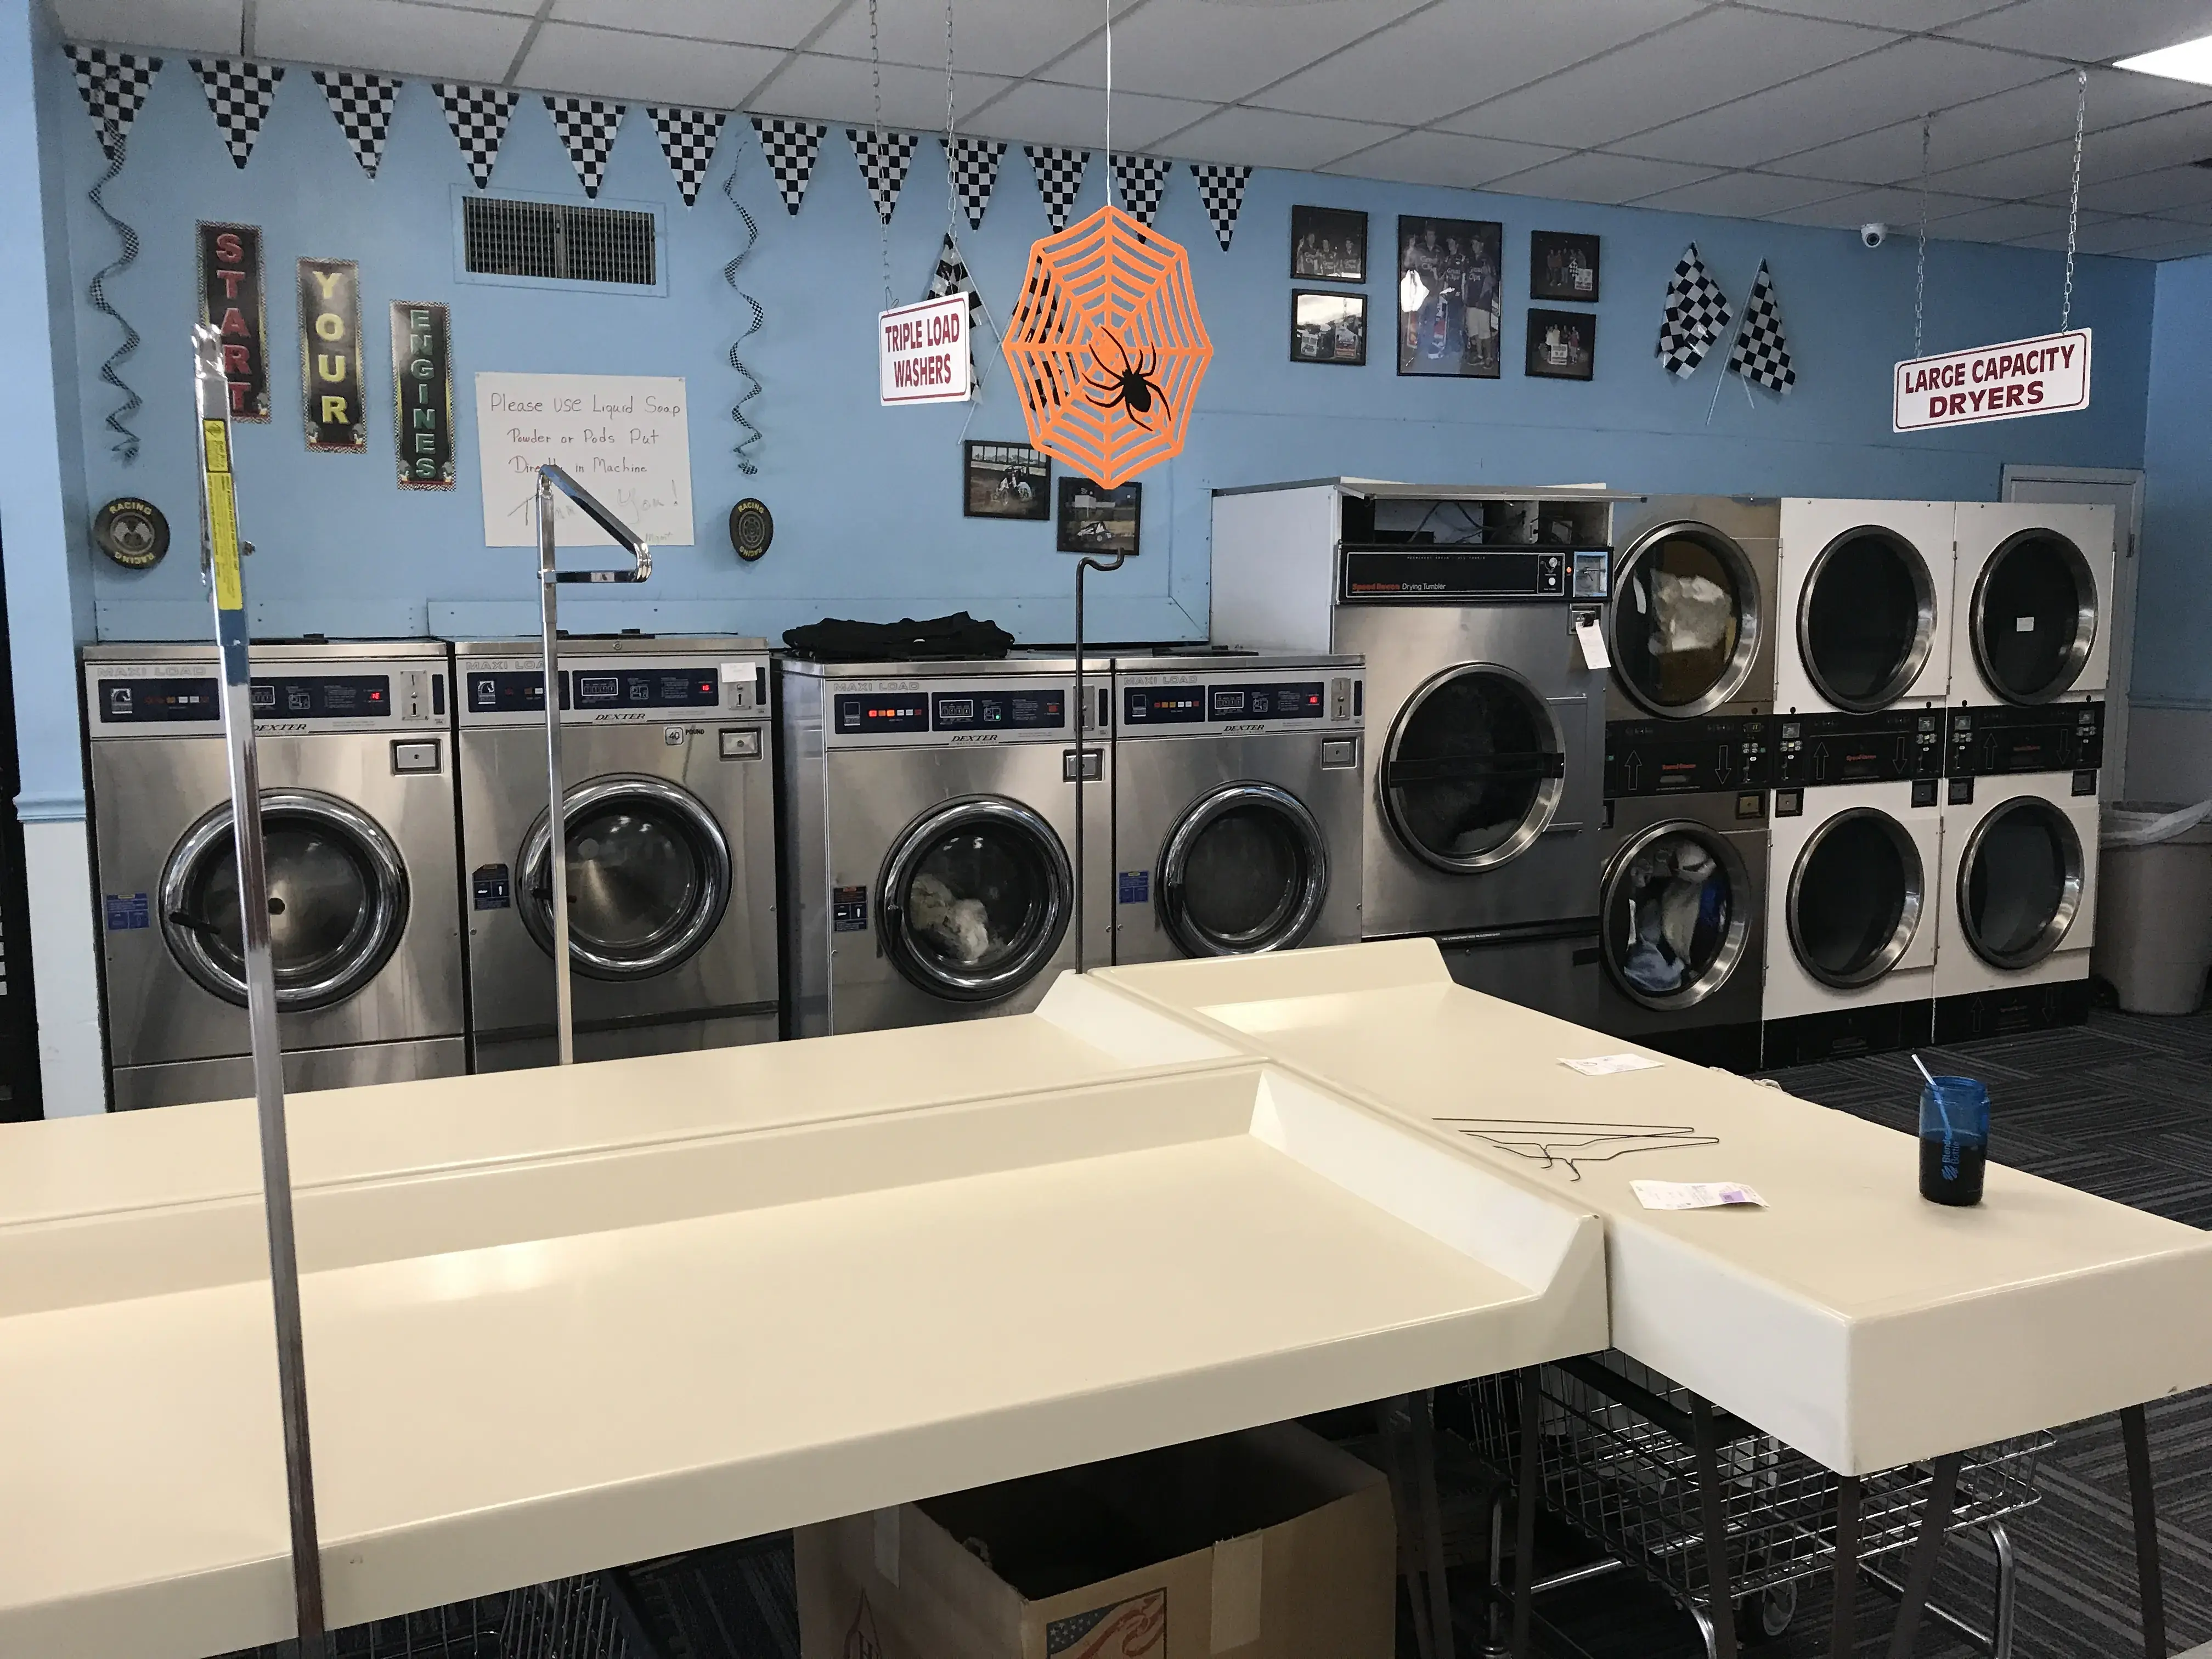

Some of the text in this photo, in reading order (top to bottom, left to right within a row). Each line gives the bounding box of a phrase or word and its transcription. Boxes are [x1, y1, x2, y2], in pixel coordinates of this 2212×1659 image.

[216, 233, 251, 411] START
[885, 313, 960, 353] TRIPLE LOAD
[312, 271, 350, 425] YOUR
[894, 353, 951, 388] WASHERS
[1905, 344, 2075, 394] LARGE CAPACITY
[410, 309, 437, 478] ENGINES
[1929, 381, 2044, 419] DRYERS
[491, 393, 543, 411] Please
[645, 396, 680, 417] Soap
[507, 428, 551, 444] Powder
[584, 427, 615, 443] Pods
[630, 428, 659, 444] Put
[575, 463, 584, 473] in
[593, 456, 647, 473] Machine
[109, 501, 152, 515] RACING
[738, 502, 764, 514] RACING
[1402, 583, 1421, 591] Drying
[97, 667, 206, 677] MAXI LOAD
[466, 661, 544, 670] MAXI LOA
[834, 682, 919, 691] MAXI LOAD
[1163, 675, 1197, 684] LOAD
[668, 731, 680, 740] 40
